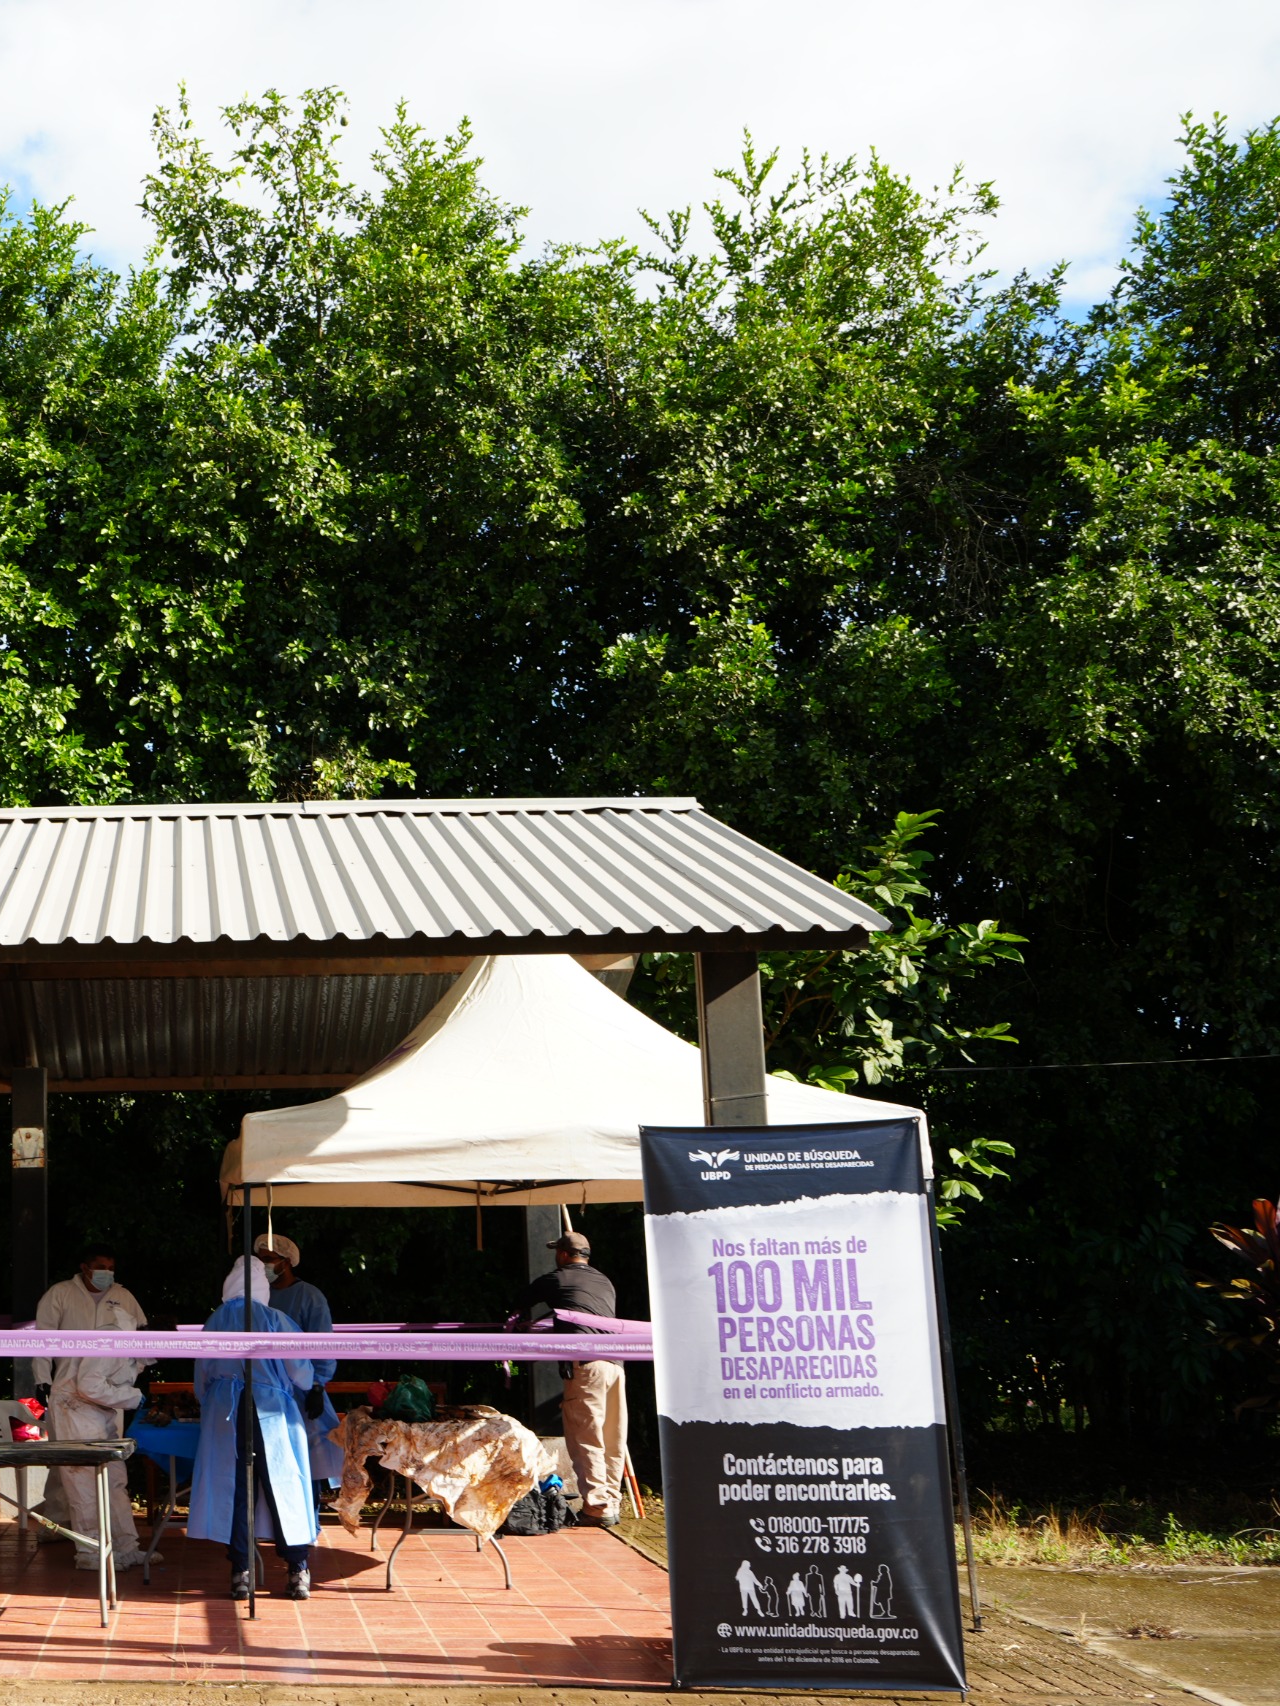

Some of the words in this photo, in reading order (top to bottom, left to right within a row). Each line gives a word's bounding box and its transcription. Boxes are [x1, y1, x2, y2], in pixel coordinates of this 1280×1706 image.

[743, 1152, 785, 1163] UNIDAD
[787, 1151, 802, 1161] DE
[803, 1149, 861, 1161] BÚSQUEDA
[754, 1163, 788, 1171] PERSONAS
[788, 1162, 810, 1170] DADAS
[825, 1160, 875, 1169] DESAPARECIDAS
[700, 1171, 732, 1181] UBPD
[712, 1239, 745, 1257] Nos
[750, 1237, 800, 1256] faltan
[804, 1236, 842, 1255] más
[846, 1236, 867, 1254] de
[707, 1260, 782, 1314] 100
[792, 1258, 873, 1312] MIL
[718, 1314, 876, 1353] PERSONAS
[61, 1340, 74, 1349] NO
[76, 1340, 98, 1349] PASE
[114, 1338, 142, 1349] MISIÓN
[145, 1340, 202, 1350] HUMANITARIA
[218, 1341, 232, 1351] NO
[234, 1341, 255, 1350] PASE
[273, 1339, 301, 1350] MISIÓN
[304, 1341, 361, 1350] HUMANITARIA
[378, 1343, 392, 1351] NO
[394, 1343, 416, 1352] PASE
[432, 1341, 461, 1352] MISIÓN
[463, 1342, 521, 1352] HUMANITARIA
[594, 1341, 624, 1352] MISIÓN
[721, 1355, 878, 1381] DESAPARECIDAS
[723, 1386, 740, 1399] en
[744, 1384, 757, 1399] el
[760, 1383, 821, 1399] conflicto
[826, 1382, 884, 1398] armado.
[723, 1453, 839, 1476] Contáctenos
[842, 1457, 883, 1480] para
[718, 1479, 772, 1505] poder
[775, 1479, 897, 1501] encontrarles.
[768, 1516, 870, 1534] 018000-117175
[775, 1536, 799, 1554] 316
[803, 1536, 830, 1553] 278
[833, 1536, 867, 1554] 3918
[734, 1623, 919, 1642] www.unidadbusqueda.gov.co
